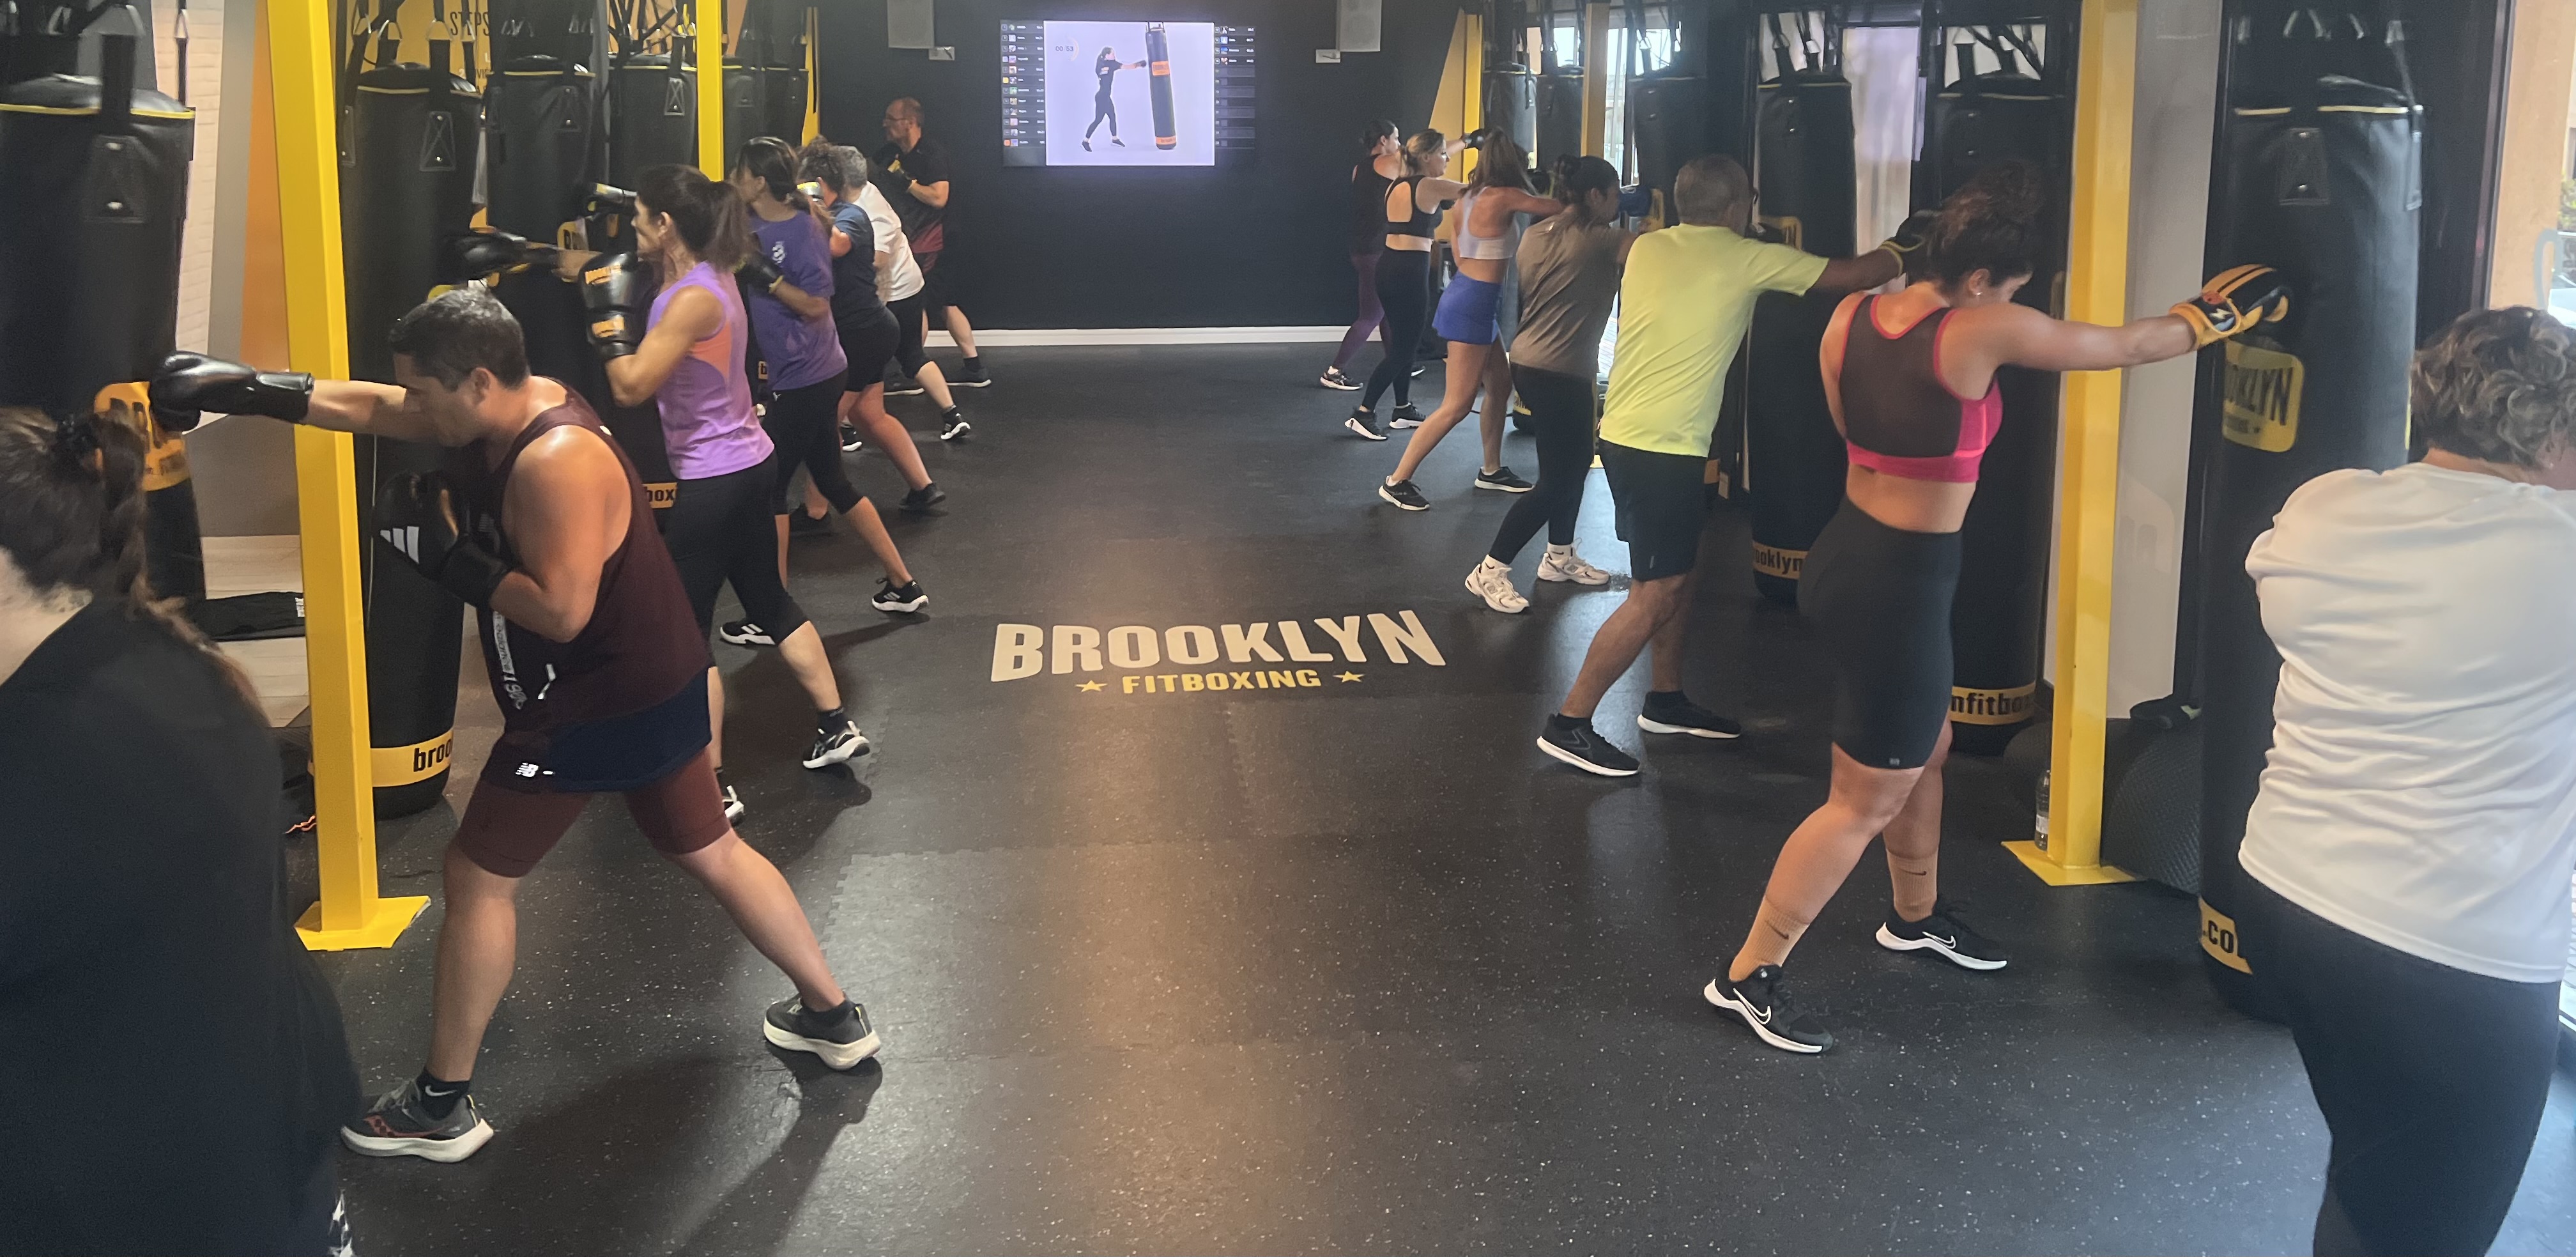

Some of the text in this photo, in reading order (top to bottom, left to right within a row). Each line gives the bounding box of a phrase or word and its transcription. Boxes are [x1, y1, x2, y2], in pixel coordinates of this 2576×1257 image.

[1753, 548, 1804, 575] ooklyn
[991, 609, 1447, 682] BROOKLYN
[1122, 669, 1322, 695] FITBOXING
